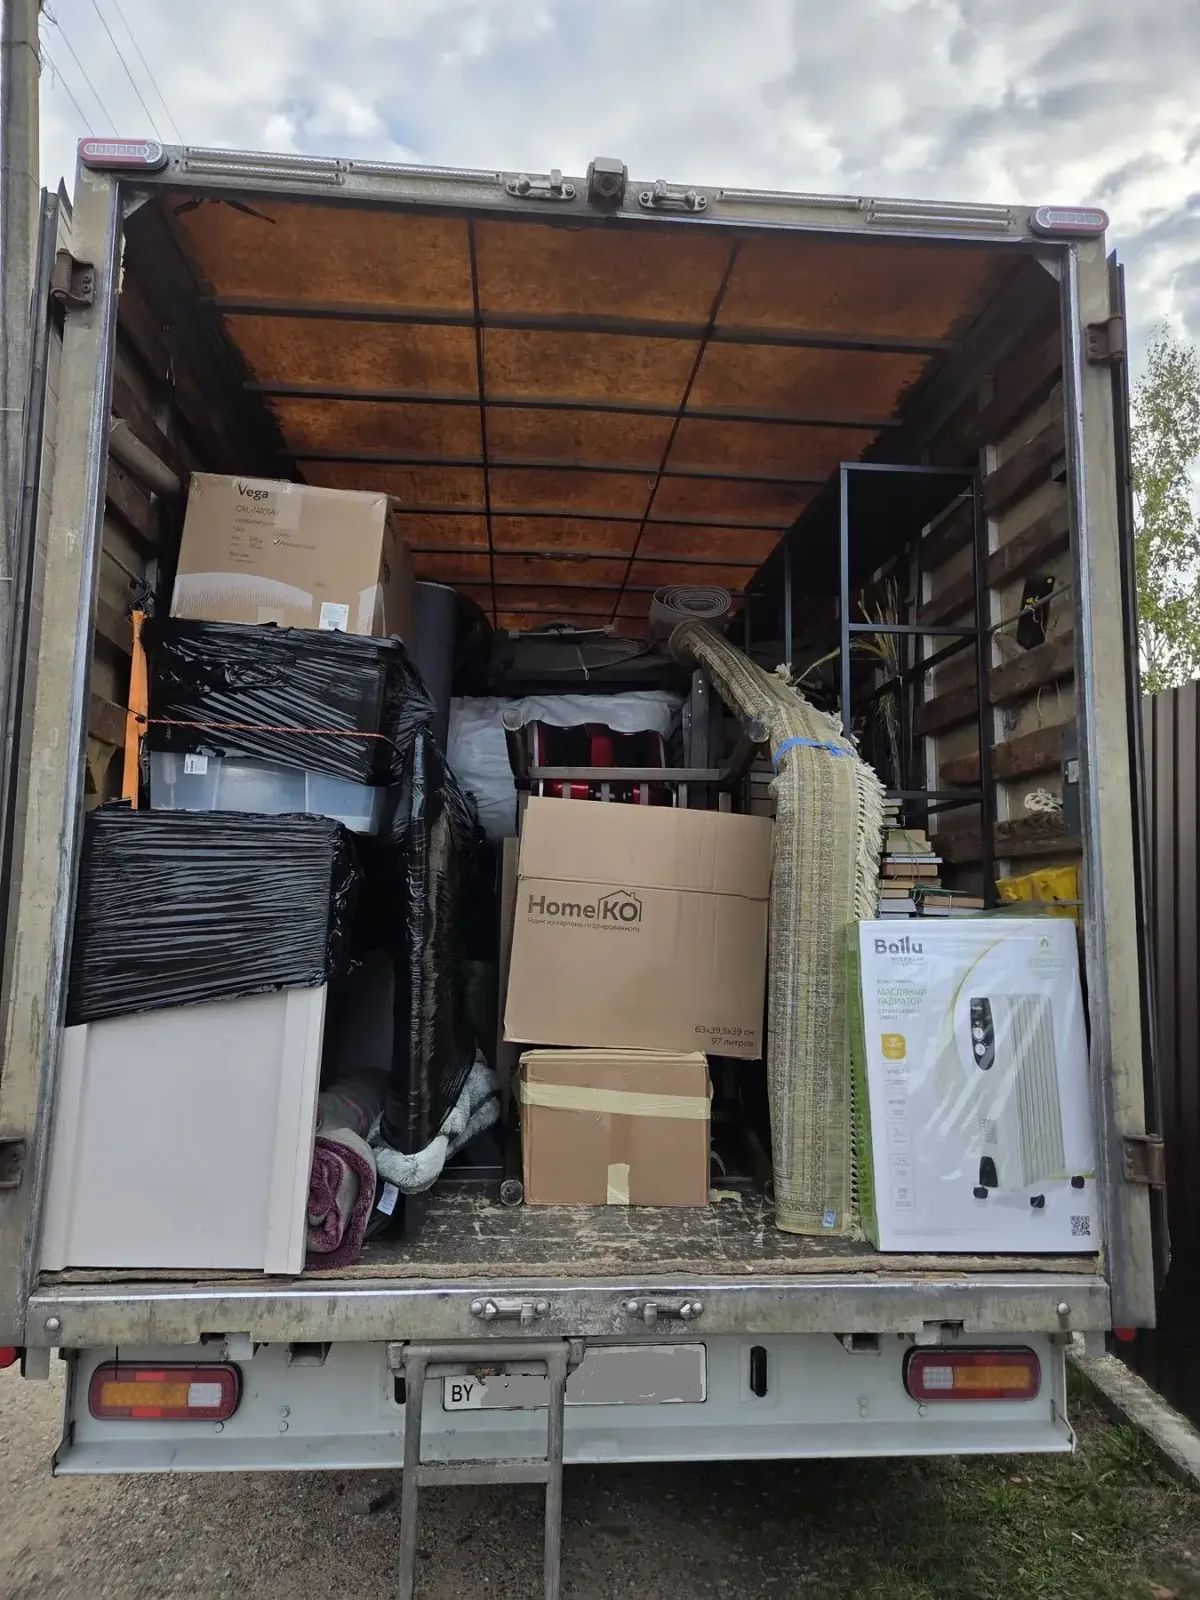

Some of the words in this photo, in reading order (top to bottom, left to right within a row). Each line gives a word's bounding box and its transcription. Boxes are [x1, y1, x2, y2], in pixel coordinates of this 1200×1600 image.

[237, 483, 269, 501] Vega
[874, 935, 924, 955] Ballu
[711, 1037, 722, 1045] 97
[723, 1039, 754, 1048] литров
[451, 1384, 474, 1402] BY
